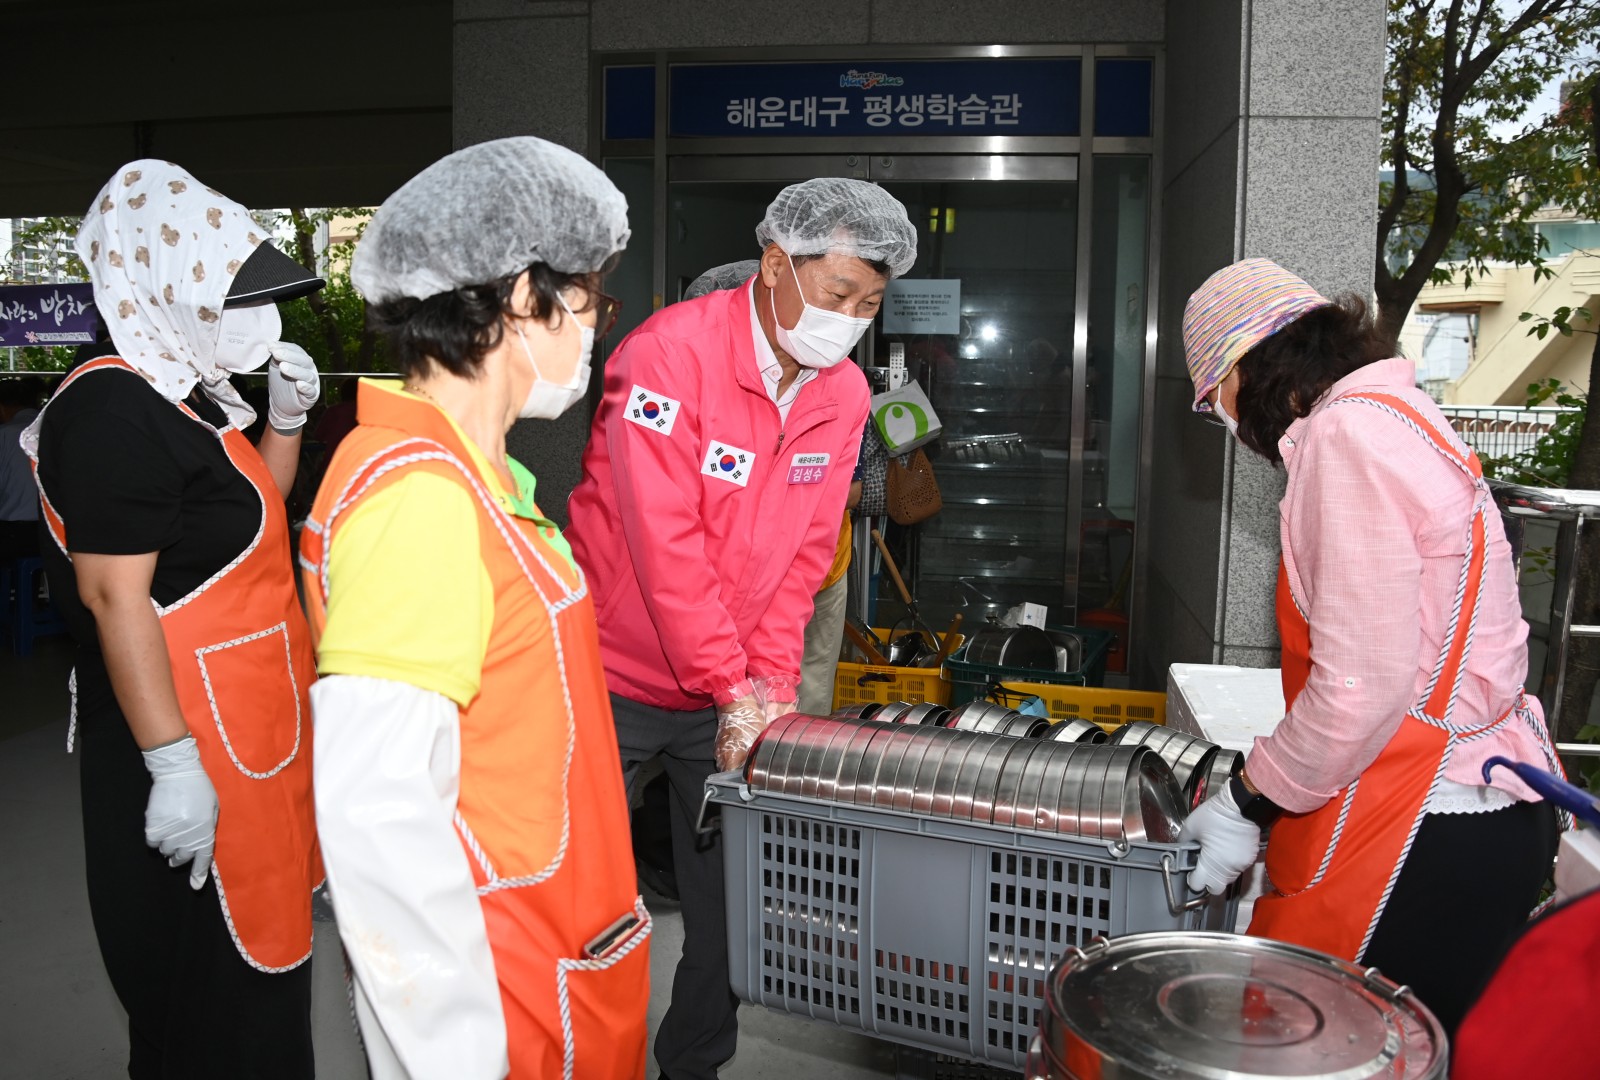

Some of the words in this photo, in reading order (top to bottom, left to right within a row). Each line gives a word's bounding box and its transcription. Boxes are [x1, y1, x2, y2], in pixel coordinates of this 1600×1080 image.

[727, 97, 850, 128] 해운대구
[863, 93, 1022, 127] 평생학습관
[0, 300, 38, 324] 사랑의
[40, 289, 94, 327] 밥차
[793, 468, 822, 482] 김성수
